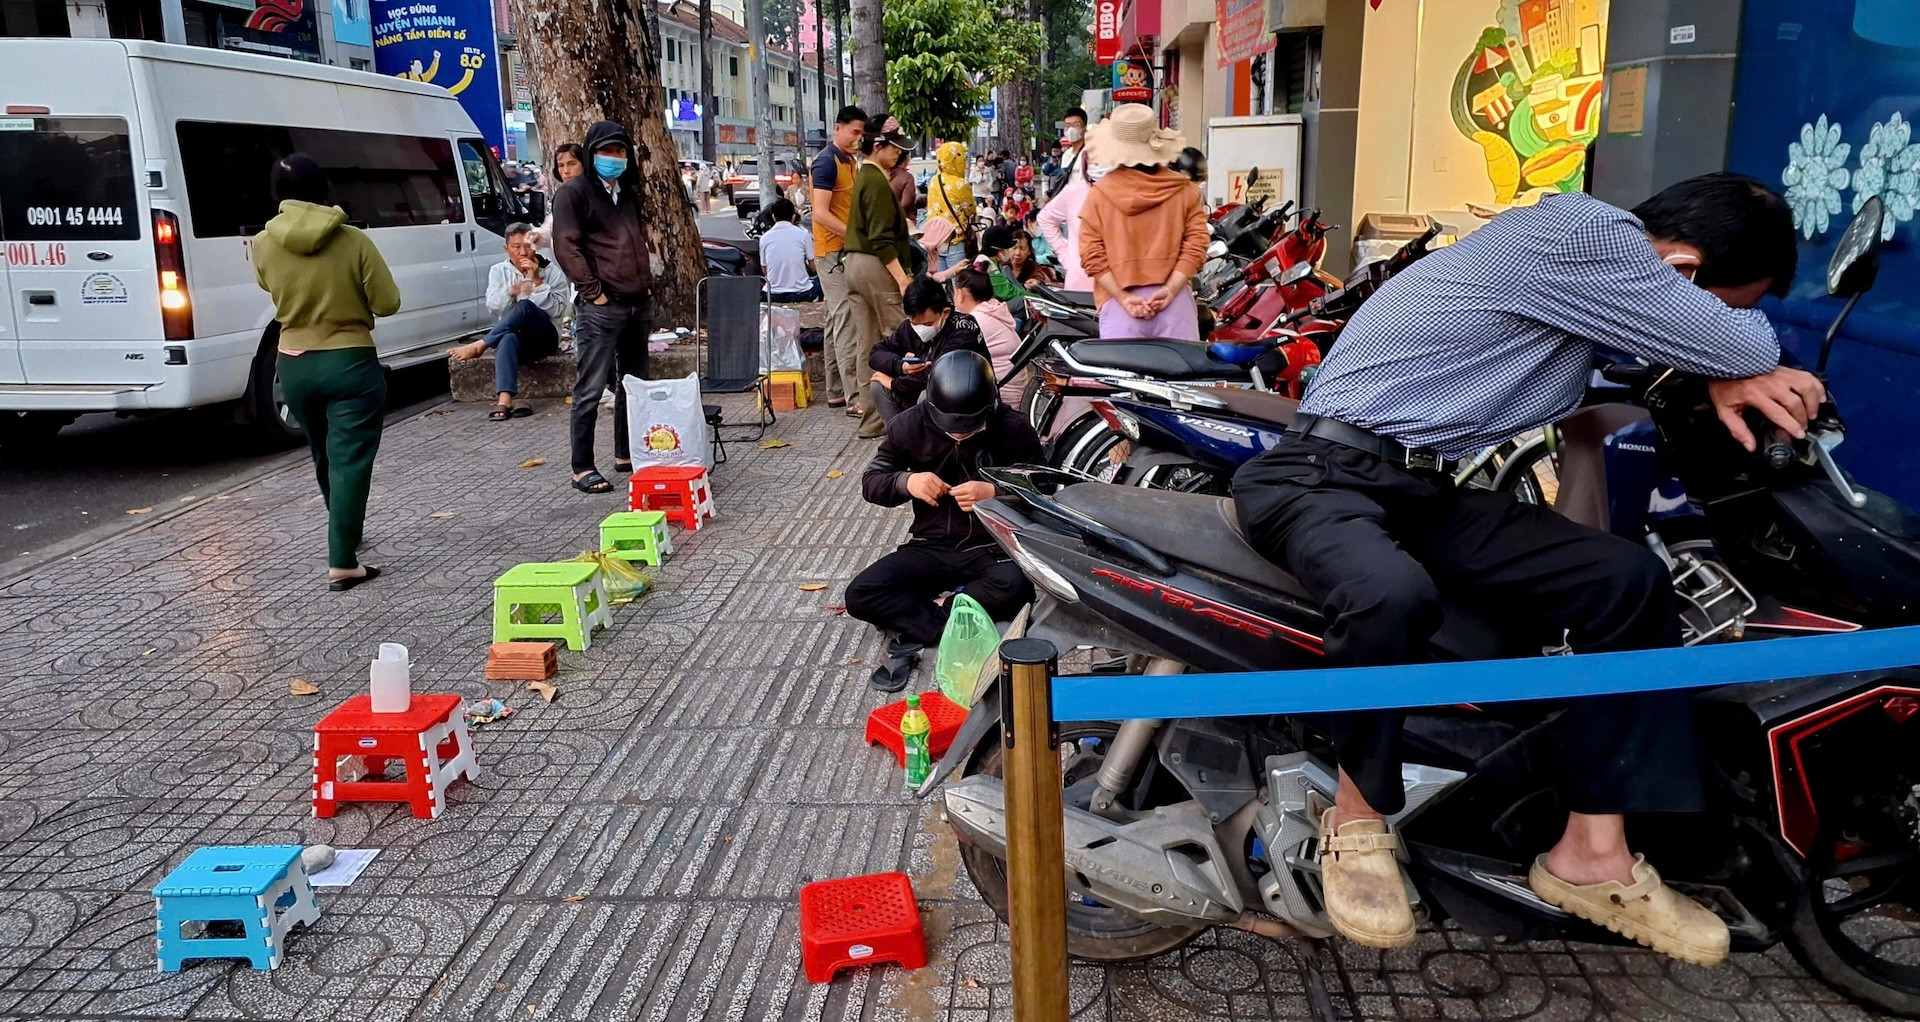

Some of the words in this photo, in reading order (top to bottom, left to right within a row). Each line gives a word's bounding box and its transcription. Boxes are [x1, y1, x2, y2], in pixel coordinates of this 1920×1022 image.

[387, 7, 408, 20] HỌC
[409, 3, 437, 15] ĐÚNG
[1099, 2, 1115, 39] BIBO
[374, 17, 411, 35] LUYỆN
[413, 16, 456, 27] NHANH
[375, 33, 403, 47] NÂNG
[453, 29, 467, 40] SỐ
[27, 207, 62, 225] 0901
[66, 207, 84, 225] 45
[87, 207, 123, 225] 4444
[1176, 414, 1256, 438] VISION
[1618, 443, 1656, 453] HONDA
